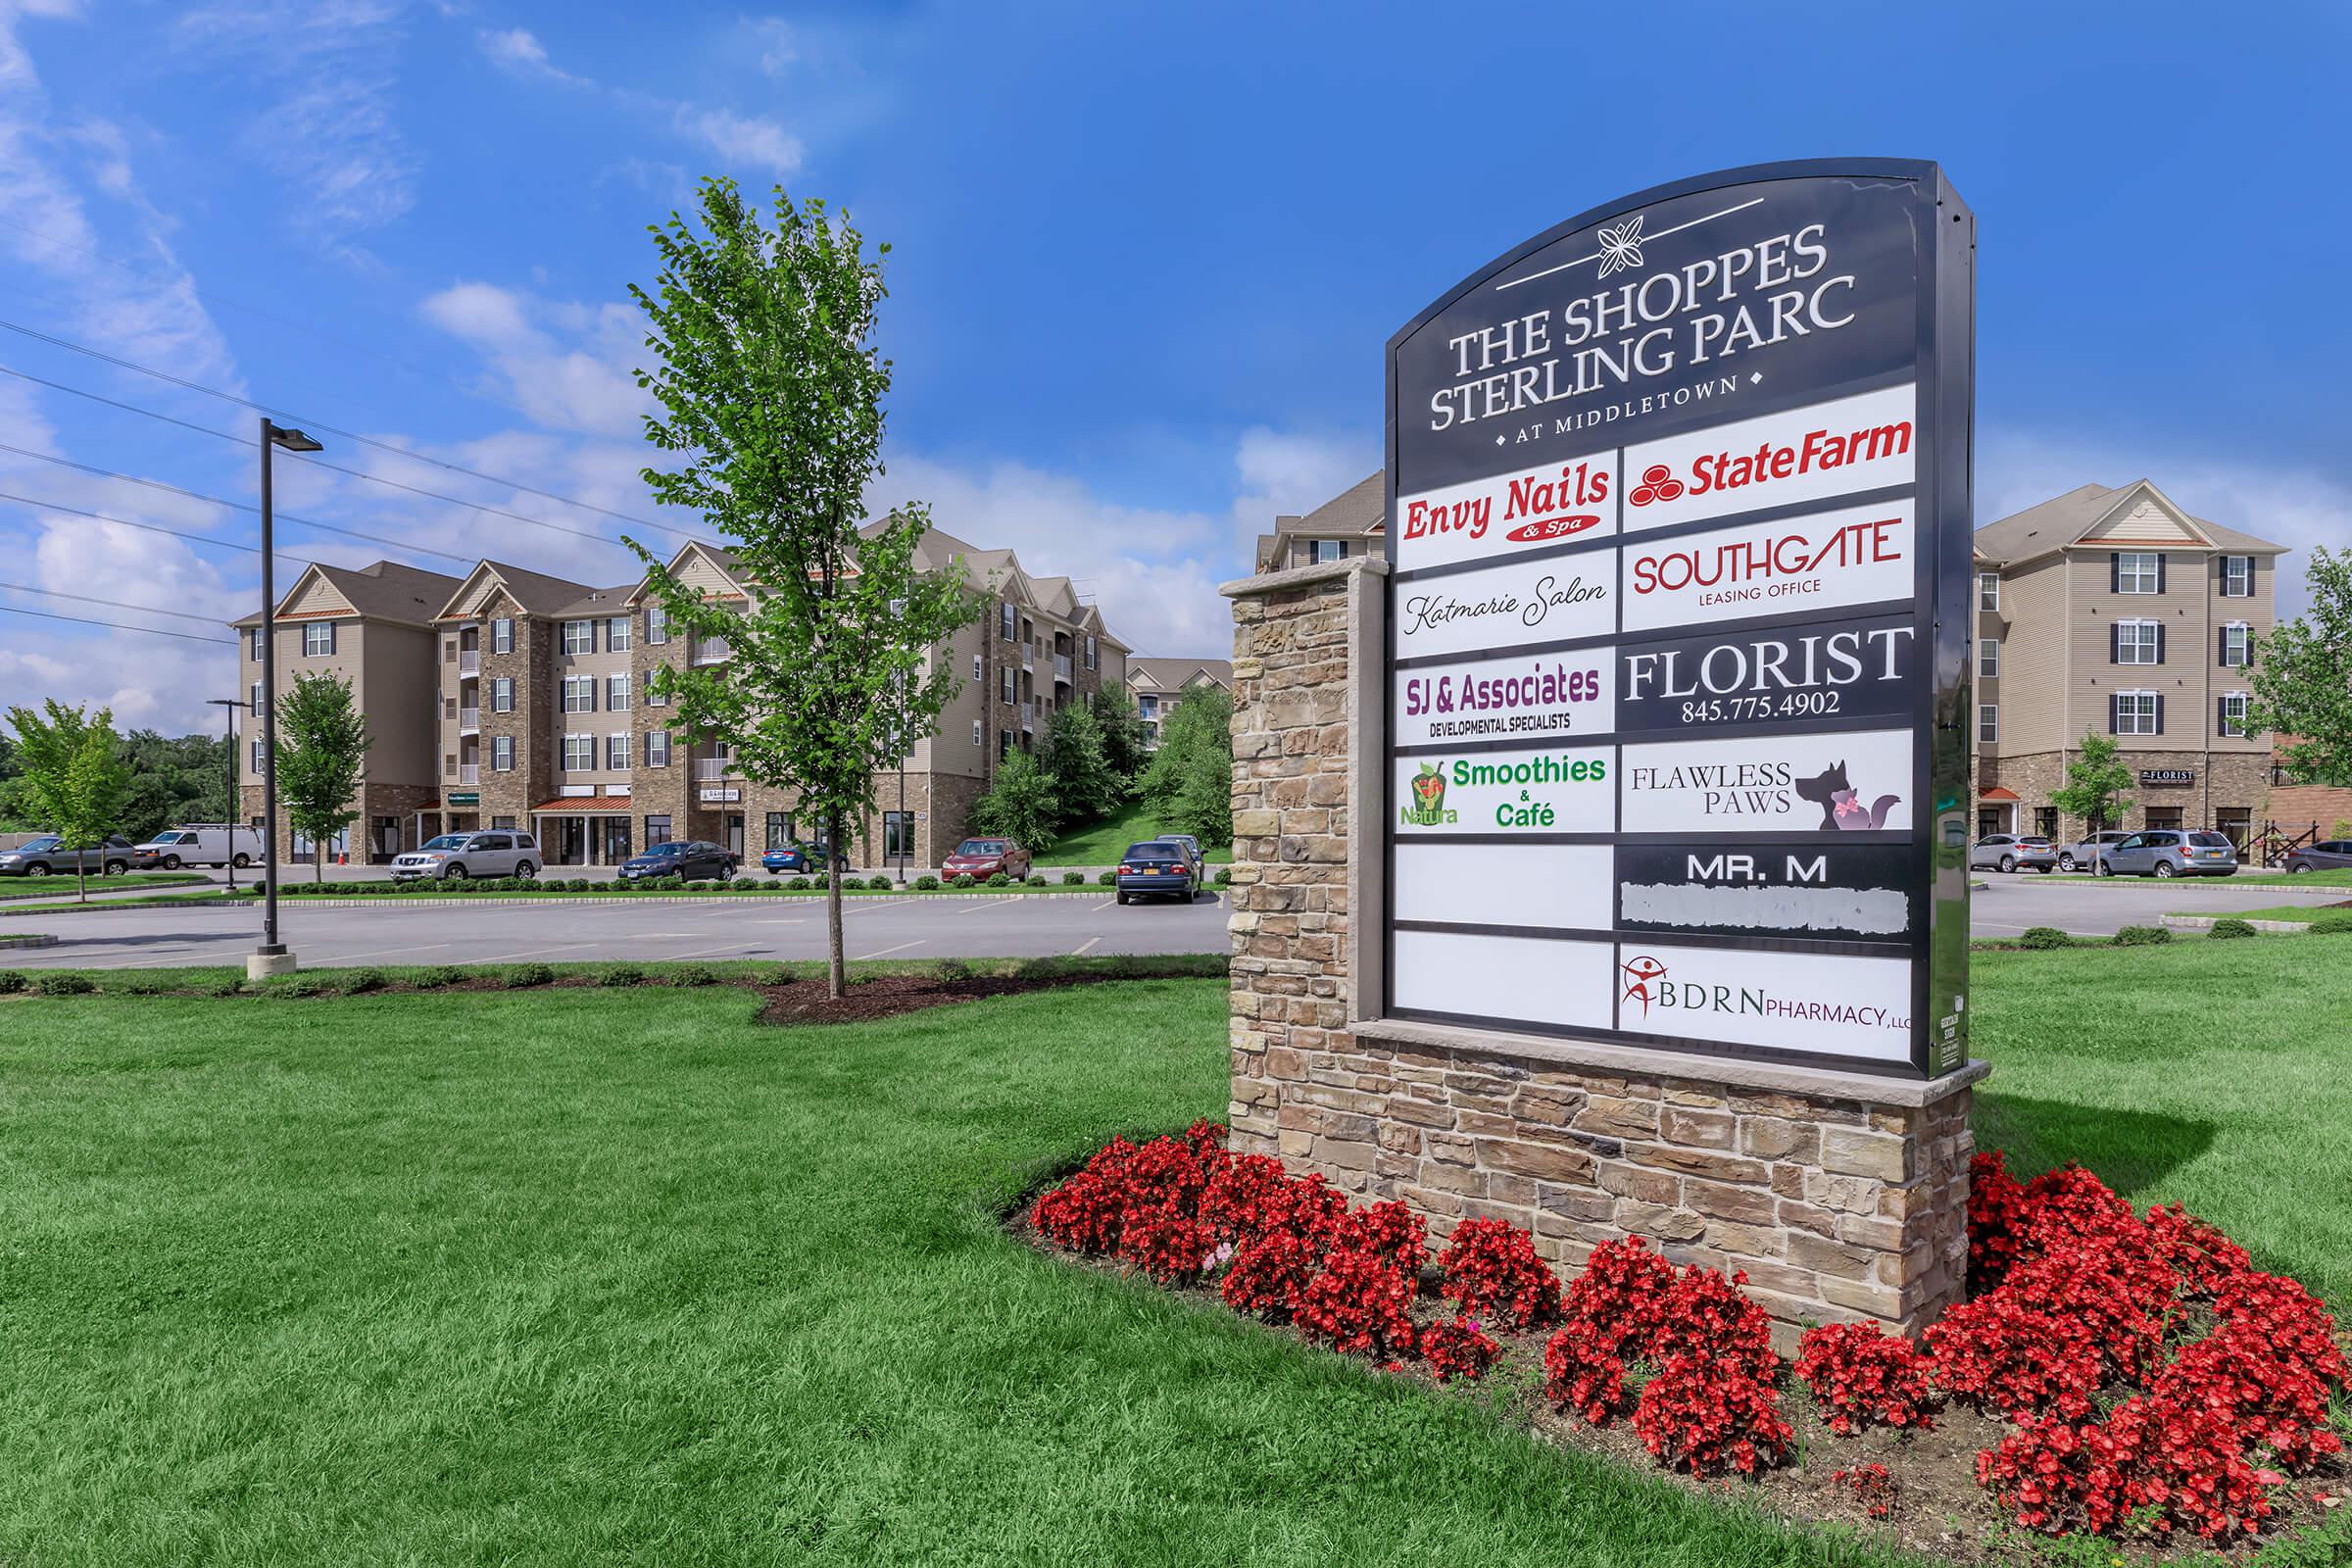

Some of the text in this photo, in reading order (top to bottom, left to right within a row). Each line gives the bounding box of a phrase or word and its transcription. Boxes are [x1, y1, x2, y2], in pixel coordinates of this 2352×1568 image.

[1449, 223, 1828, 377] THE SHOPPES
[1430, 274, 1857, 432] STERLING PARC
[1515, 375, 1740, 444] AT MIDDLETOWN
[1402, 463, 1609, 540] Envy Nails
[1522, 516, 1582, 539] & Spa
[1633, 517, 1902, 595] SOUTHGATE
[1403, 575, 1607, 635] Katmarie Salon
[1698, 579, 1822, 607] LEASING OFFICE
[1624, 626, 1915, 703] FLORIST
[1406, 662, 1599, 715] SJ & Associates
[1682, 691, 1840, 723] 845.775.4902
[1429, 712, 1571, 738] DEVELOPMENTAL SPECIALISTS
[1452, 755, 1606, 787] Smoothies
[1632, 761, 1791, 791] FLAWLESS
[2150, 770, 2193, 779] FLORIST
[1520, 789, 1530, 802] &
[1703, 790, 1791, 815] PAWS
[1400, 806, 1458, 826] Natura
[1495, 802, 1555, 827] Café
[1687, 855, 1827, 882] MR. M
